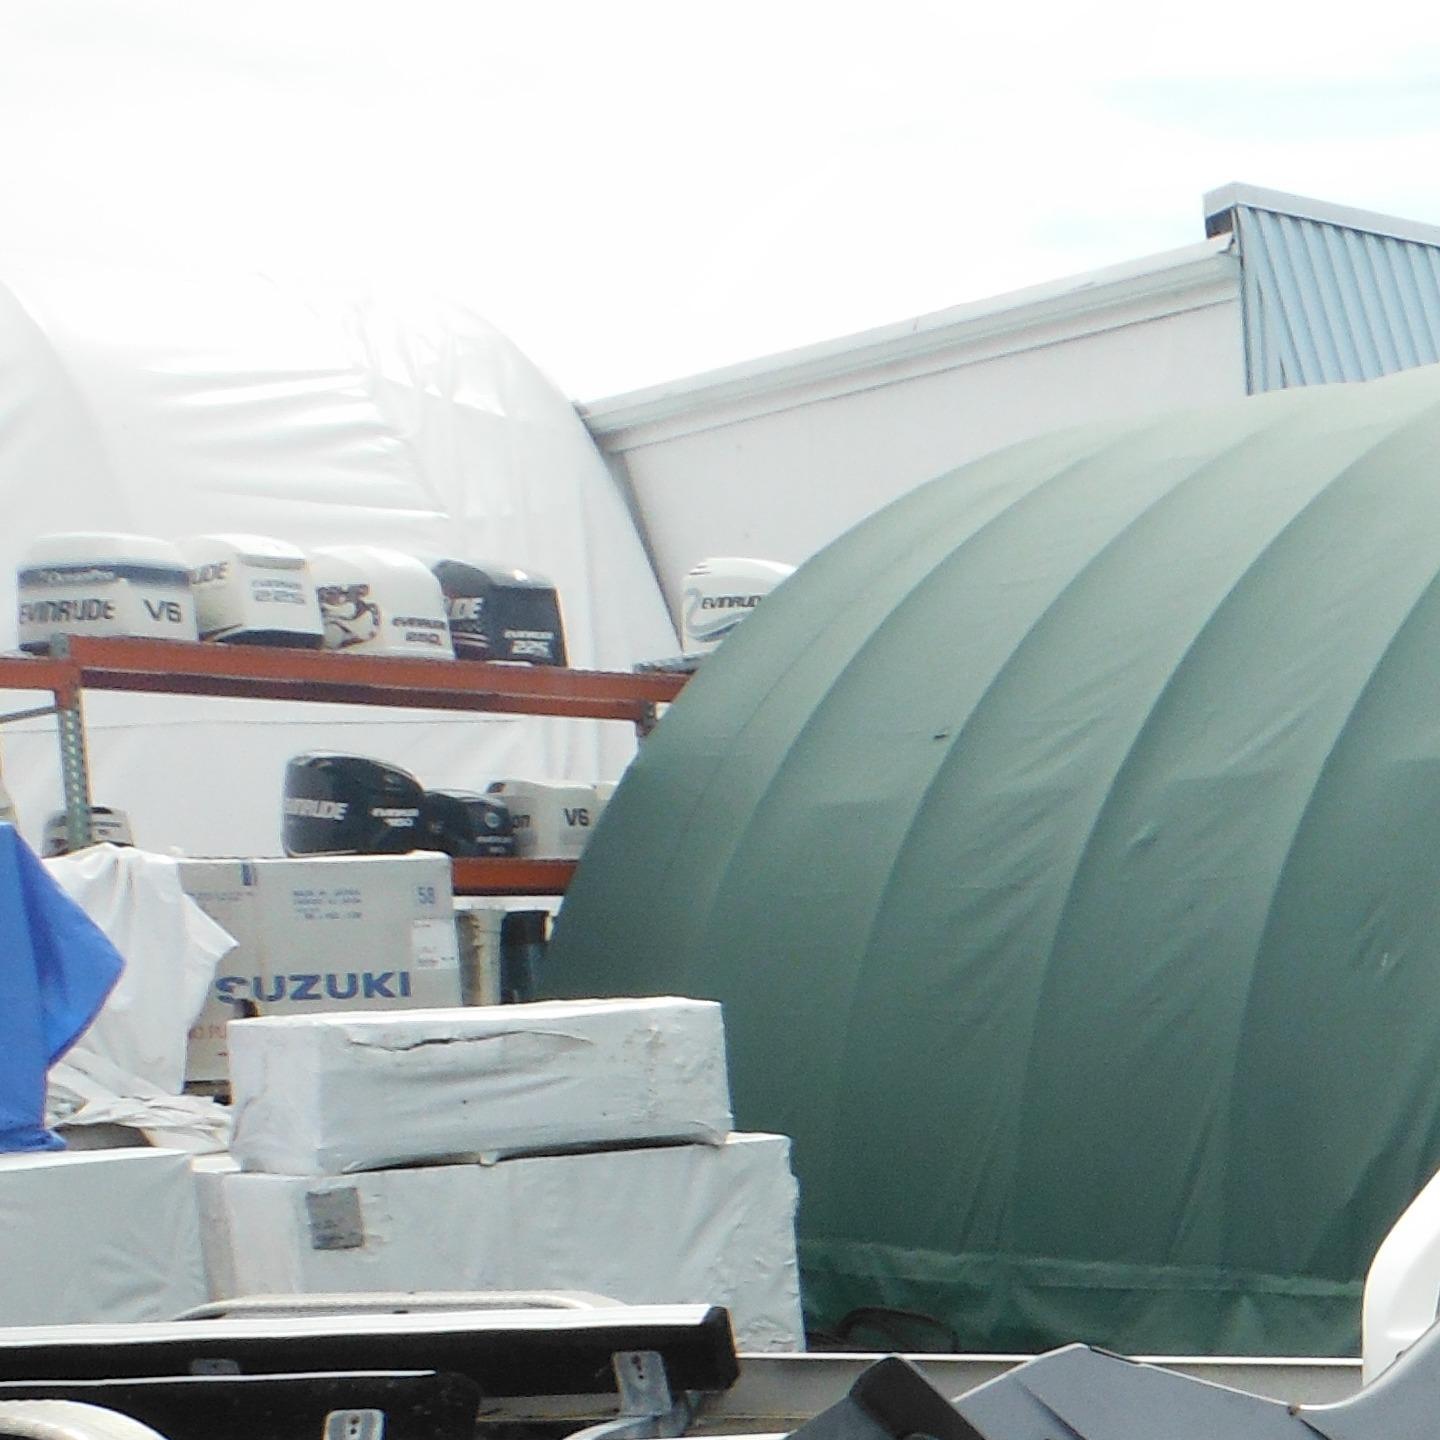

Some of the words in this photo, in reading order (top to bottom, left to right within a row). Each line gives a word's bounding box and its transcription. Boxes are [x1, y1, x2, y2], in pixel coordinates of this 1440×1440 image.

[143, 600, 182, 624] V6
[563, 807, 589, 826] V6
[215, 971, 412, 1004] SUZUKI
